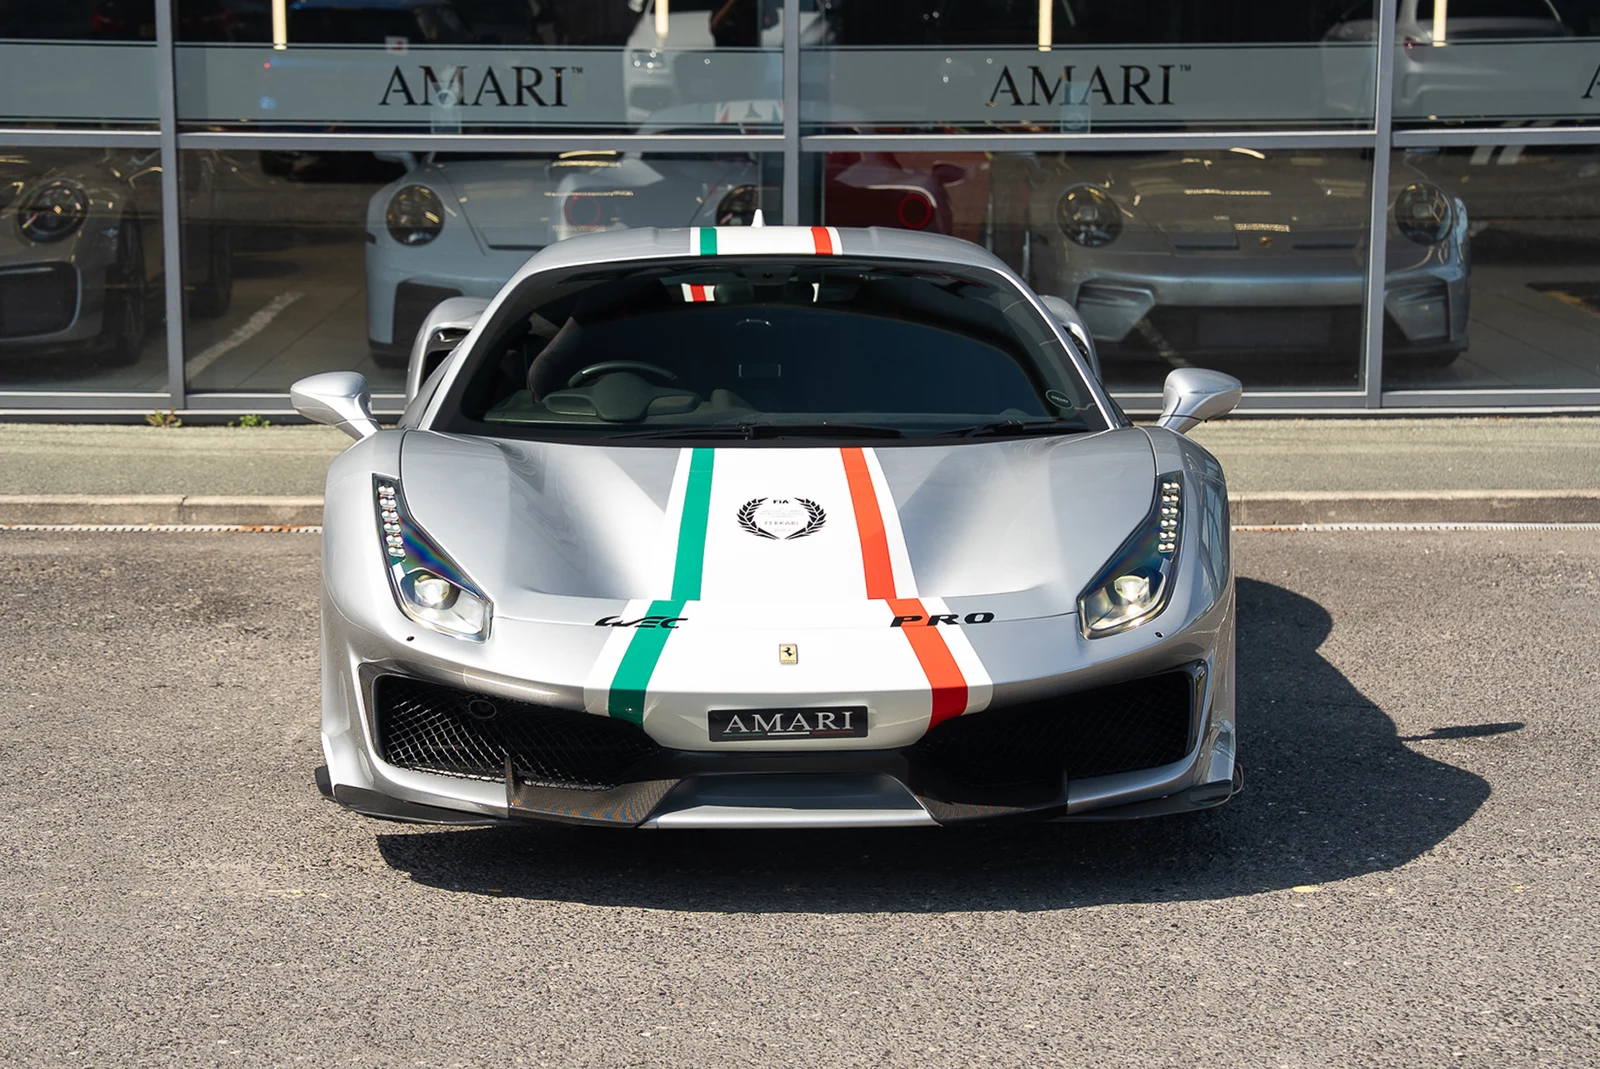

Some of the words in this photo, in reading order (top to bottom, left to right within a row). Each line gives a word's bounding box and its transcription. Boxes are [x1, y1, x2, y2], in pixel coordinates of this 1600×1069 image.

[378, 65, 568, 107] AMARI
[985, 64, 1175, 107] AMARI
[890, 612, 995, 627] PRO
[723, 711, 854, 733] AMARI
